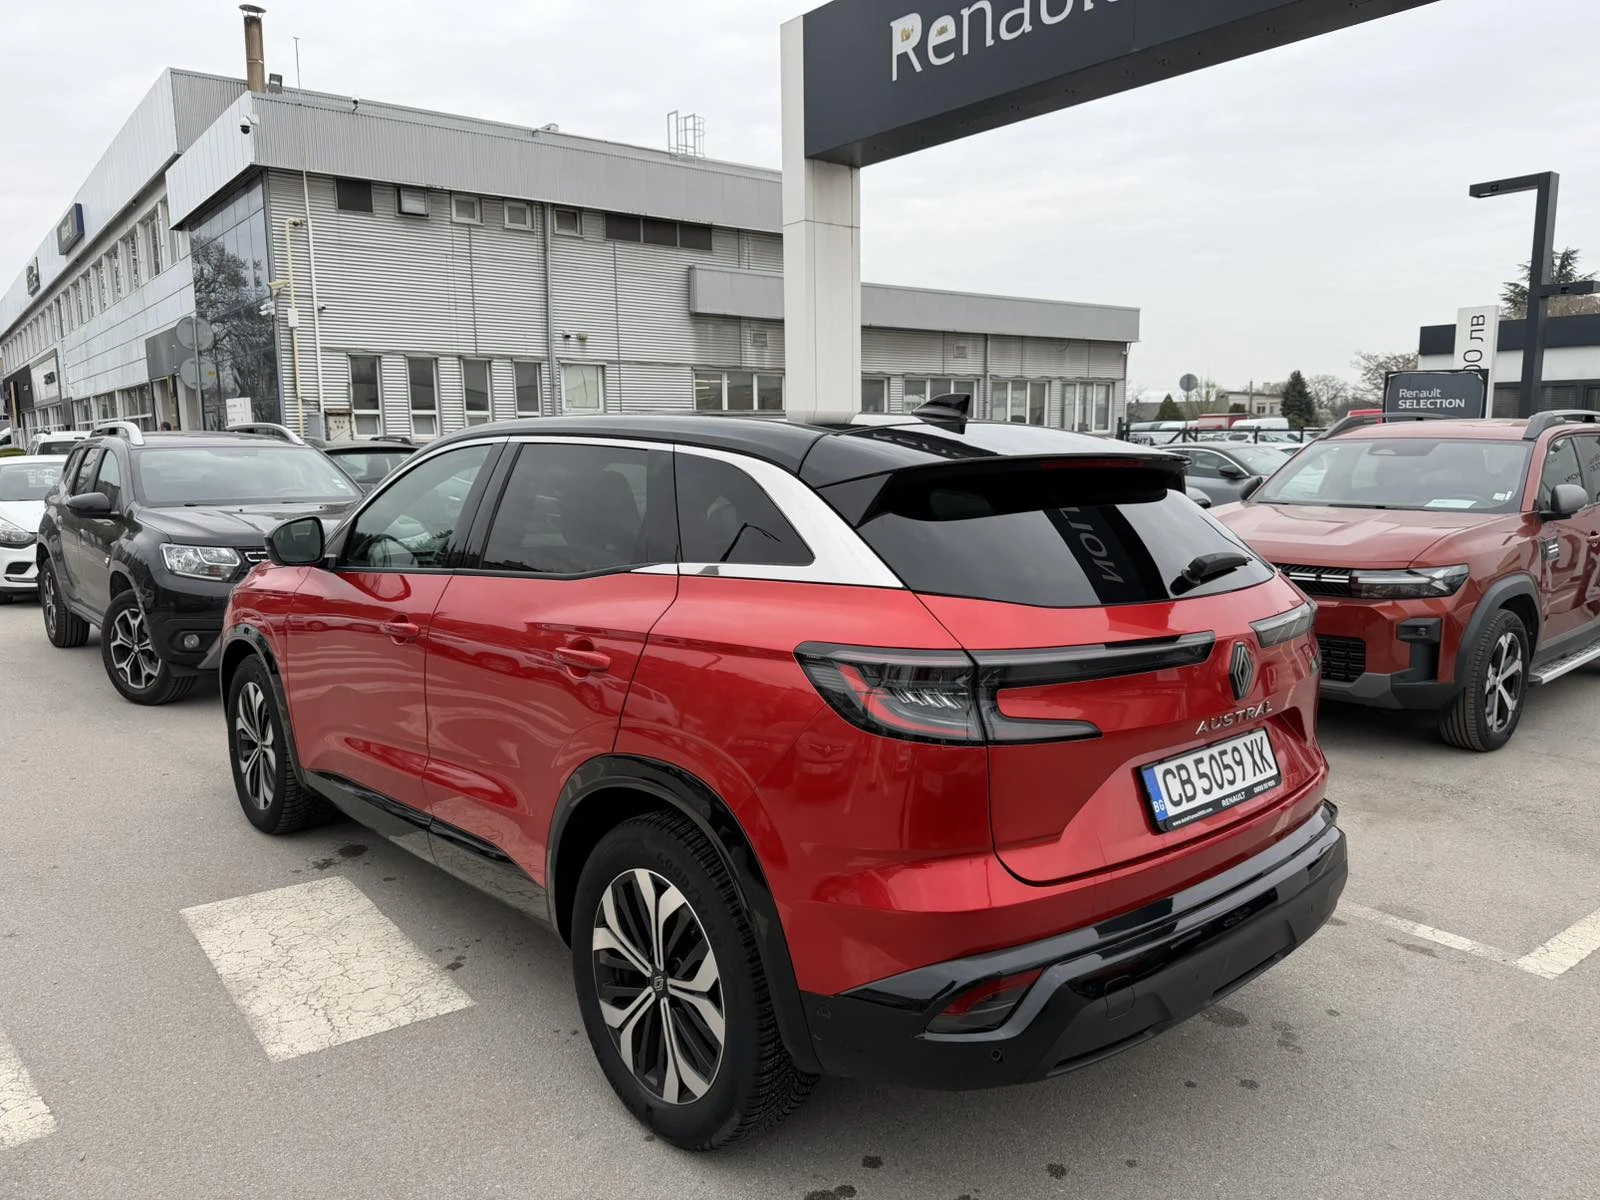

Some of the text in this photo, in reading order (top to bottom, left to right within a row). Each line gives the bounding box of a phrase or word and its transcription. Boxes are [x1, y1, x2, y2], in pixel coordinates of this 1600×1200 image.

[889, 0, 1119, 82] Renau
[1398, 388, 1442, 399] Renault
[1397, 399, 1466, 410] SELECTION
[1195, 700, 1273, 736] AUSTRAL
[1162, 736, 1274, 807] CB 5059 XK
[1152, 799, 1165, 812] BG
[1221, 791, 1246, 807] RENAULT
